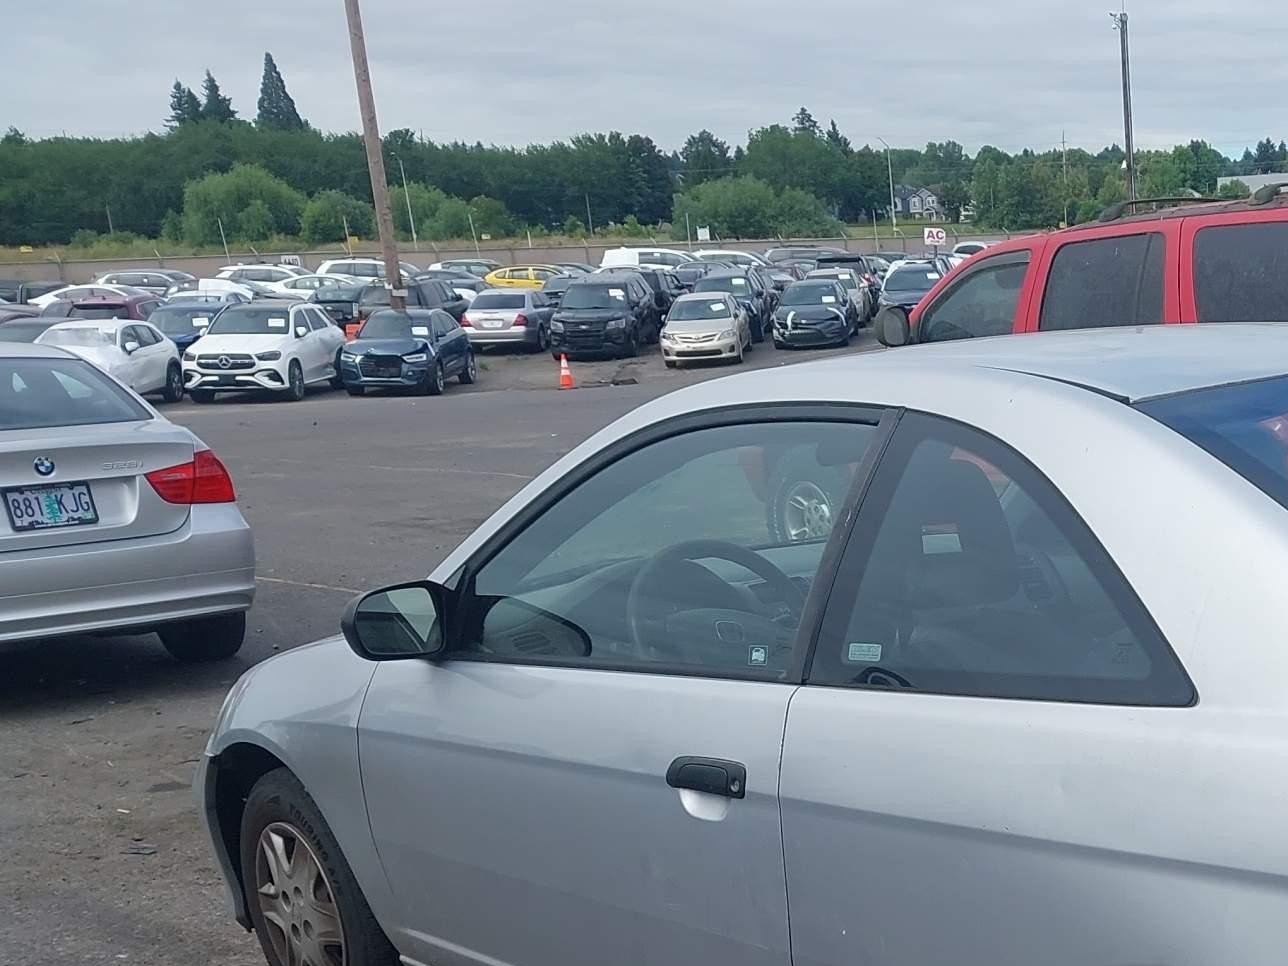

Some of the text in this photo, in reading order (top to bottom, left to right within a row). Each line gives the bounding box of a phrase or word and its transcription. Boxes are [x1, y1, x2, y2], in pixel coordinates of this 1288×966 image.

[926, 230, 945, 240] AC
[11, 491, 91, 518] 881 KJG
